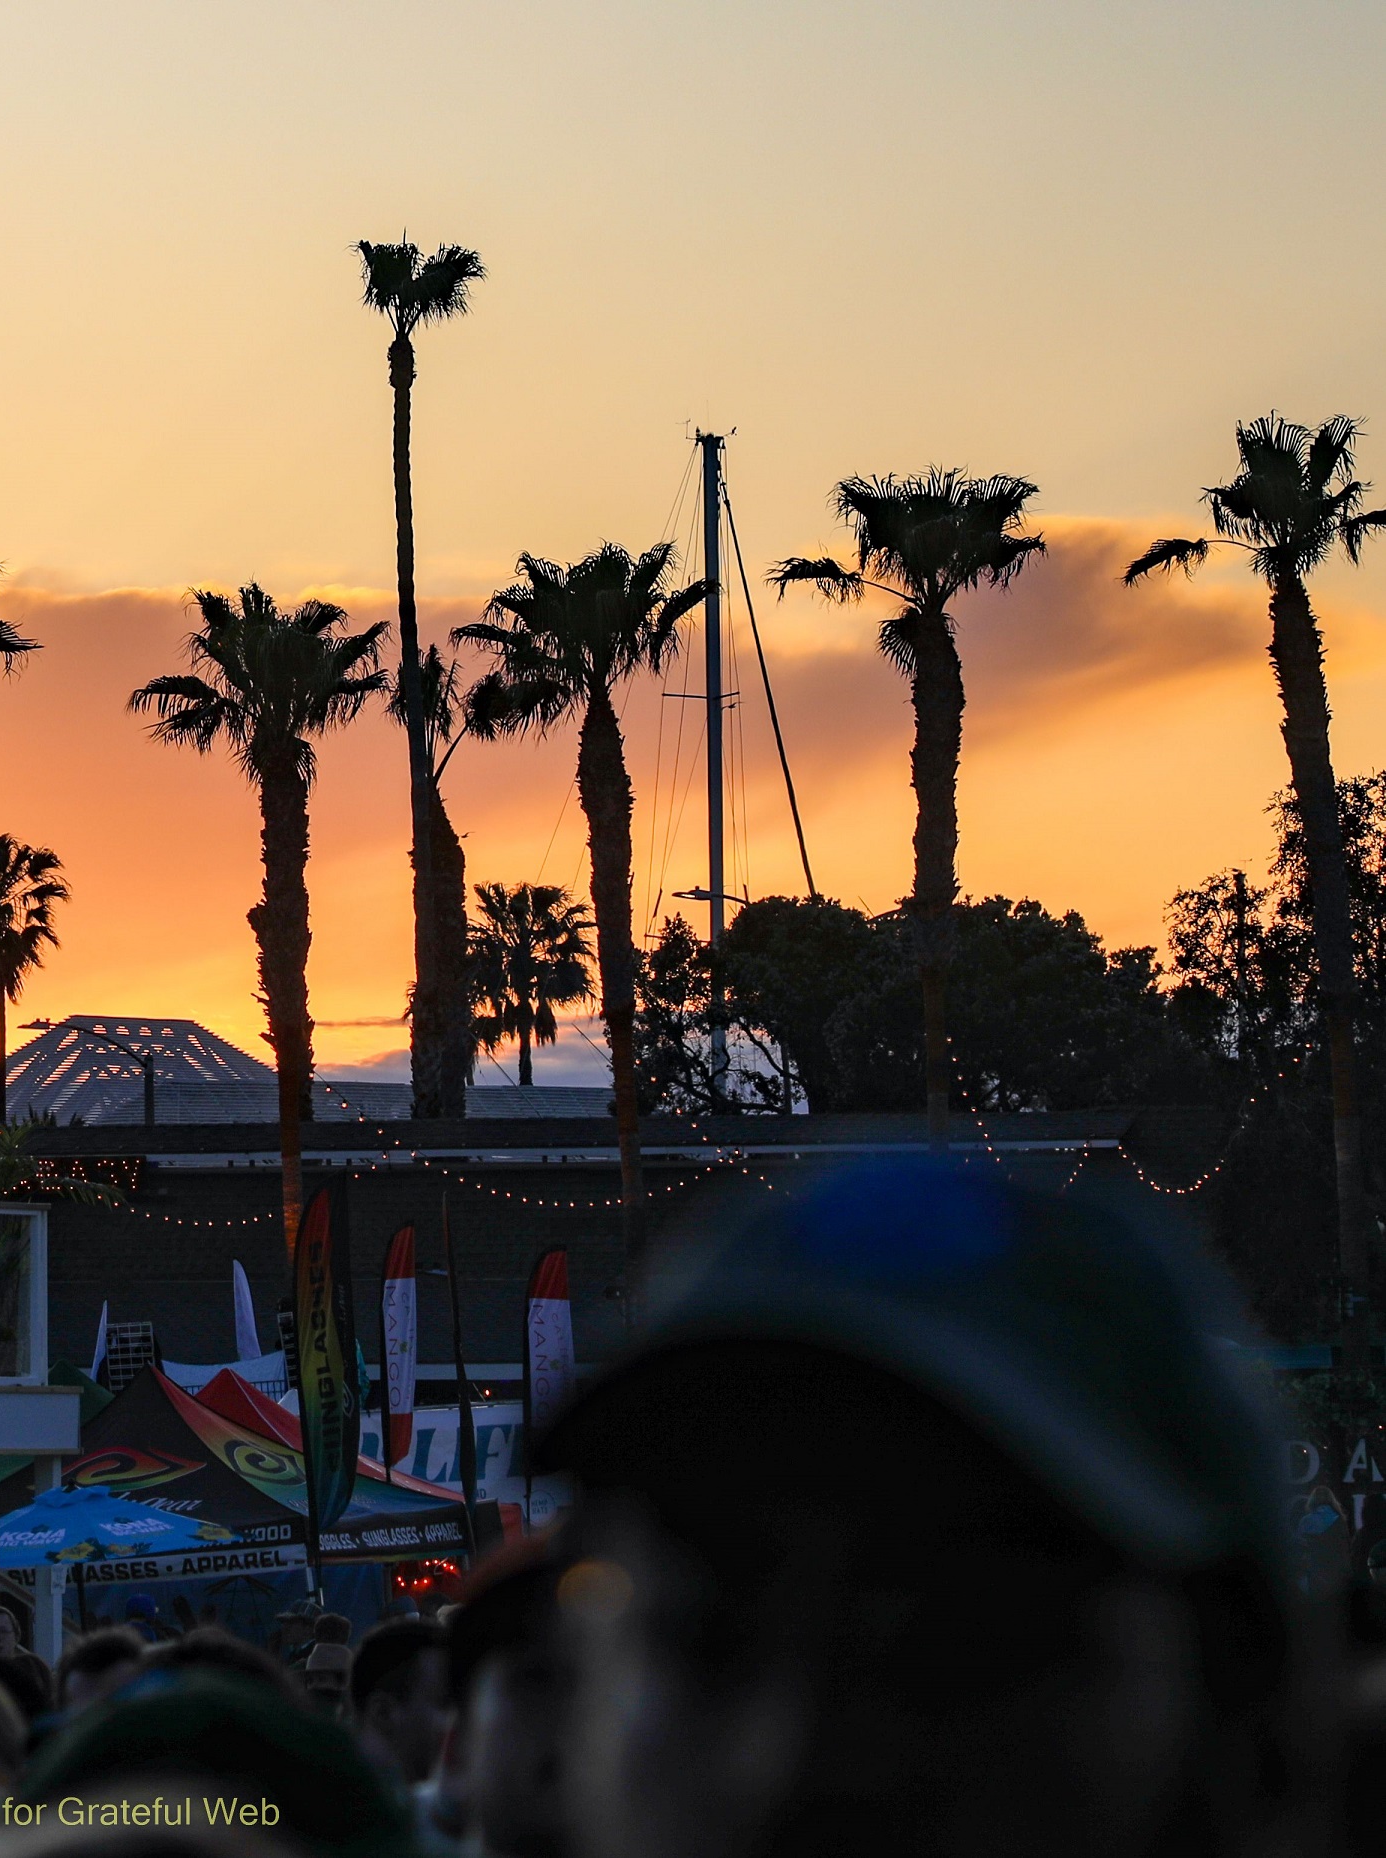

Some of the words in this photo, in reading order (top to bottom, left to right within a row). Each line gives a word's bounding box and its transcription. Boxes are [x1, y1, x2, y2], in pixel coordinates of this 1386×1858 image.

[384, 1285, 402, 1409] MANGO
[0, 1528, 66, 1541] KONA
[362, 1526, 420, 1547] SUNGLASSES
[424, 1522, 463, 1543] APPAREL
[182, 1551, 288, 1575] APPAREL
